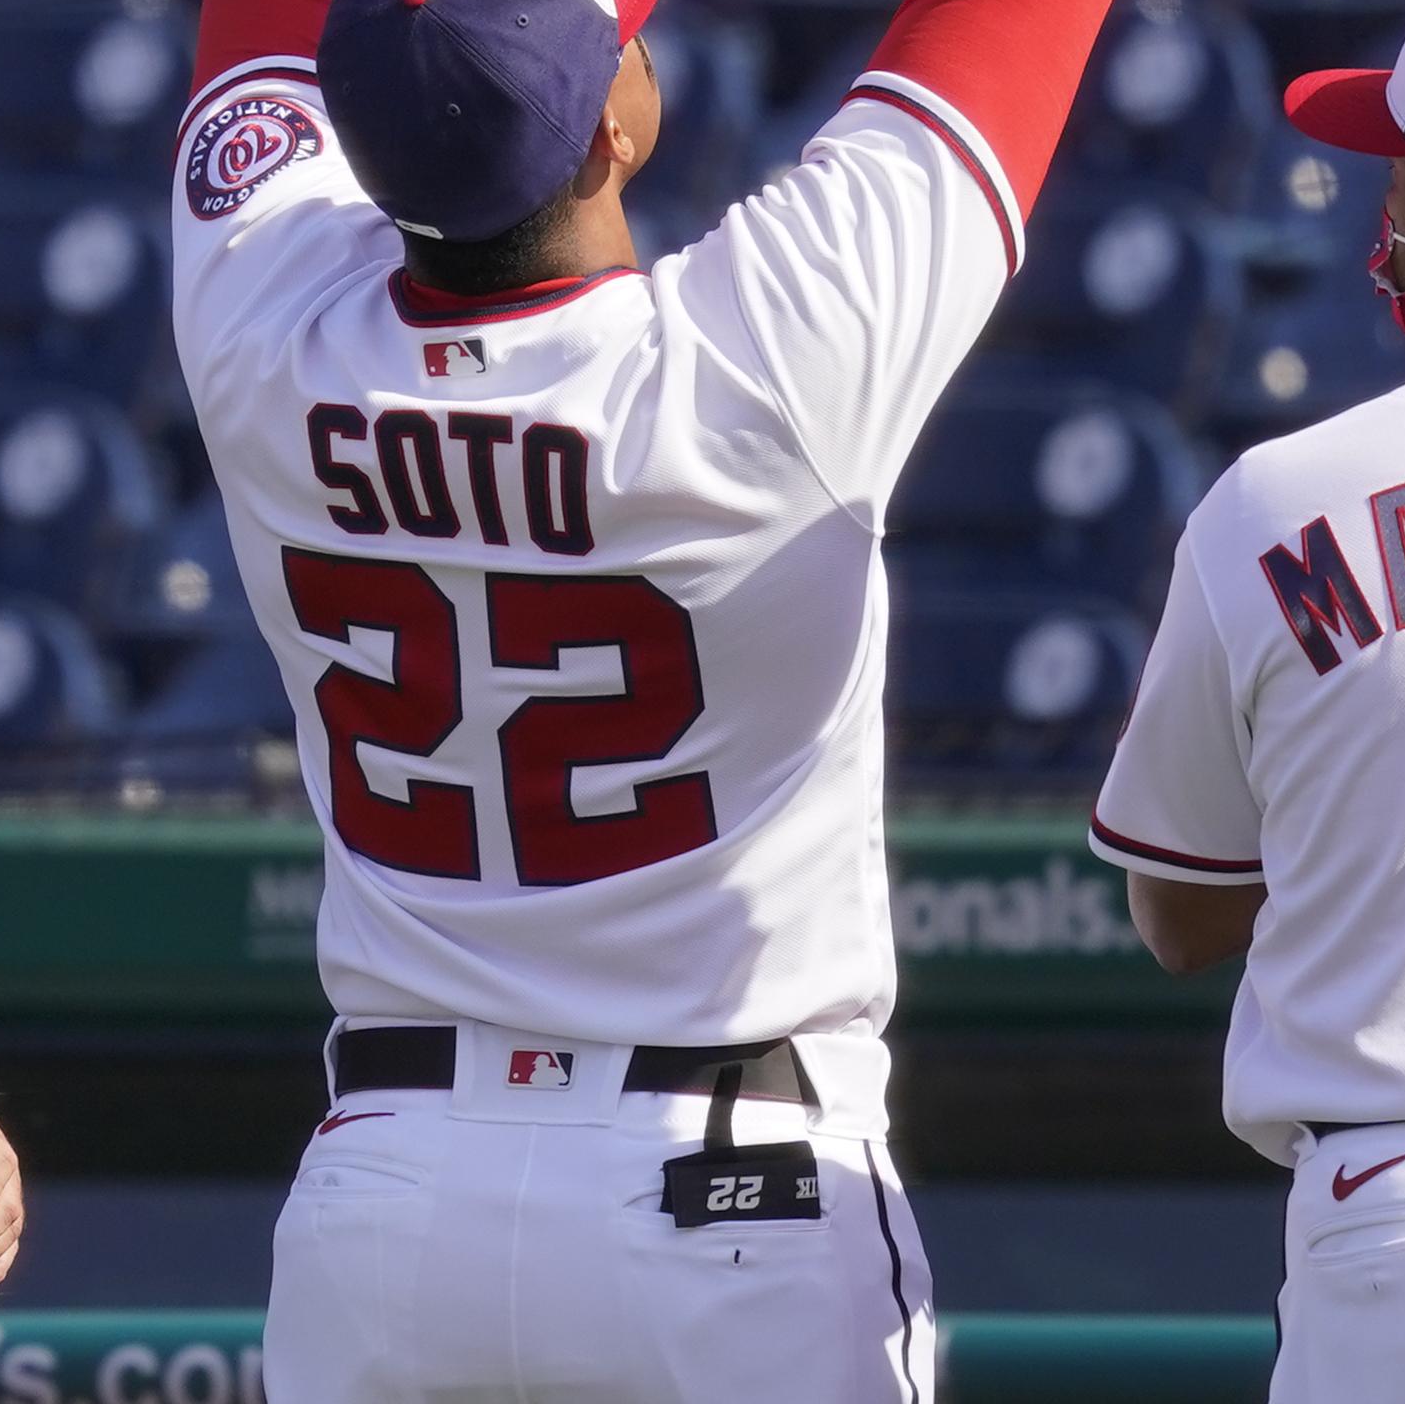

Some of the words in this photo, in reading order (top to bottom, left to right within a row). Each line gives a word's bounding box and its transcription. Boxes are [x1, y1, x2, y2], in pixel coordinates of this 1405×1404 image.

[190, 101, 292, 181] NATIONALS
[307, 402, 595, 557] SOTO
[281, 544, 719, 887] 22
[706, 1175, 764, 1212] 22
